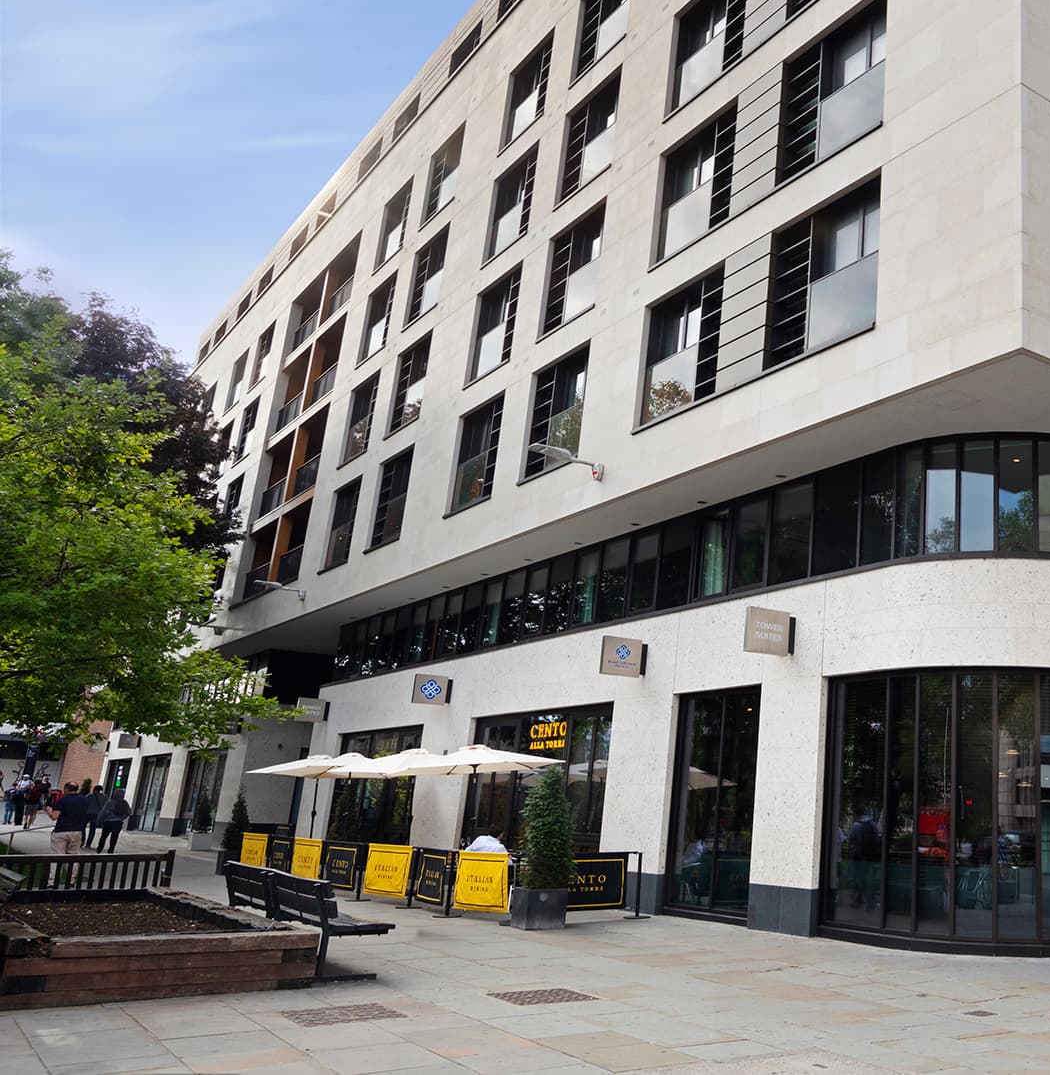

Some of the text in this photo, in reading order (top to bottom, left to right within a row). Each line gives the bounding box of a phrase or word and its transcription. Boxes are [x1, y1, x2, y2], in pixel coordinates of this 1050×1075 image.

[530, 721, 567, 739] CENTO
[529, 740, 545, 750] ALLA
[331, 860, 349, 870] CENTO
[374, 863, 398, 873] ITALIAN
[466, 874, 494, 884] ITALIAN
[567, 874, 607, 885] ENTO
